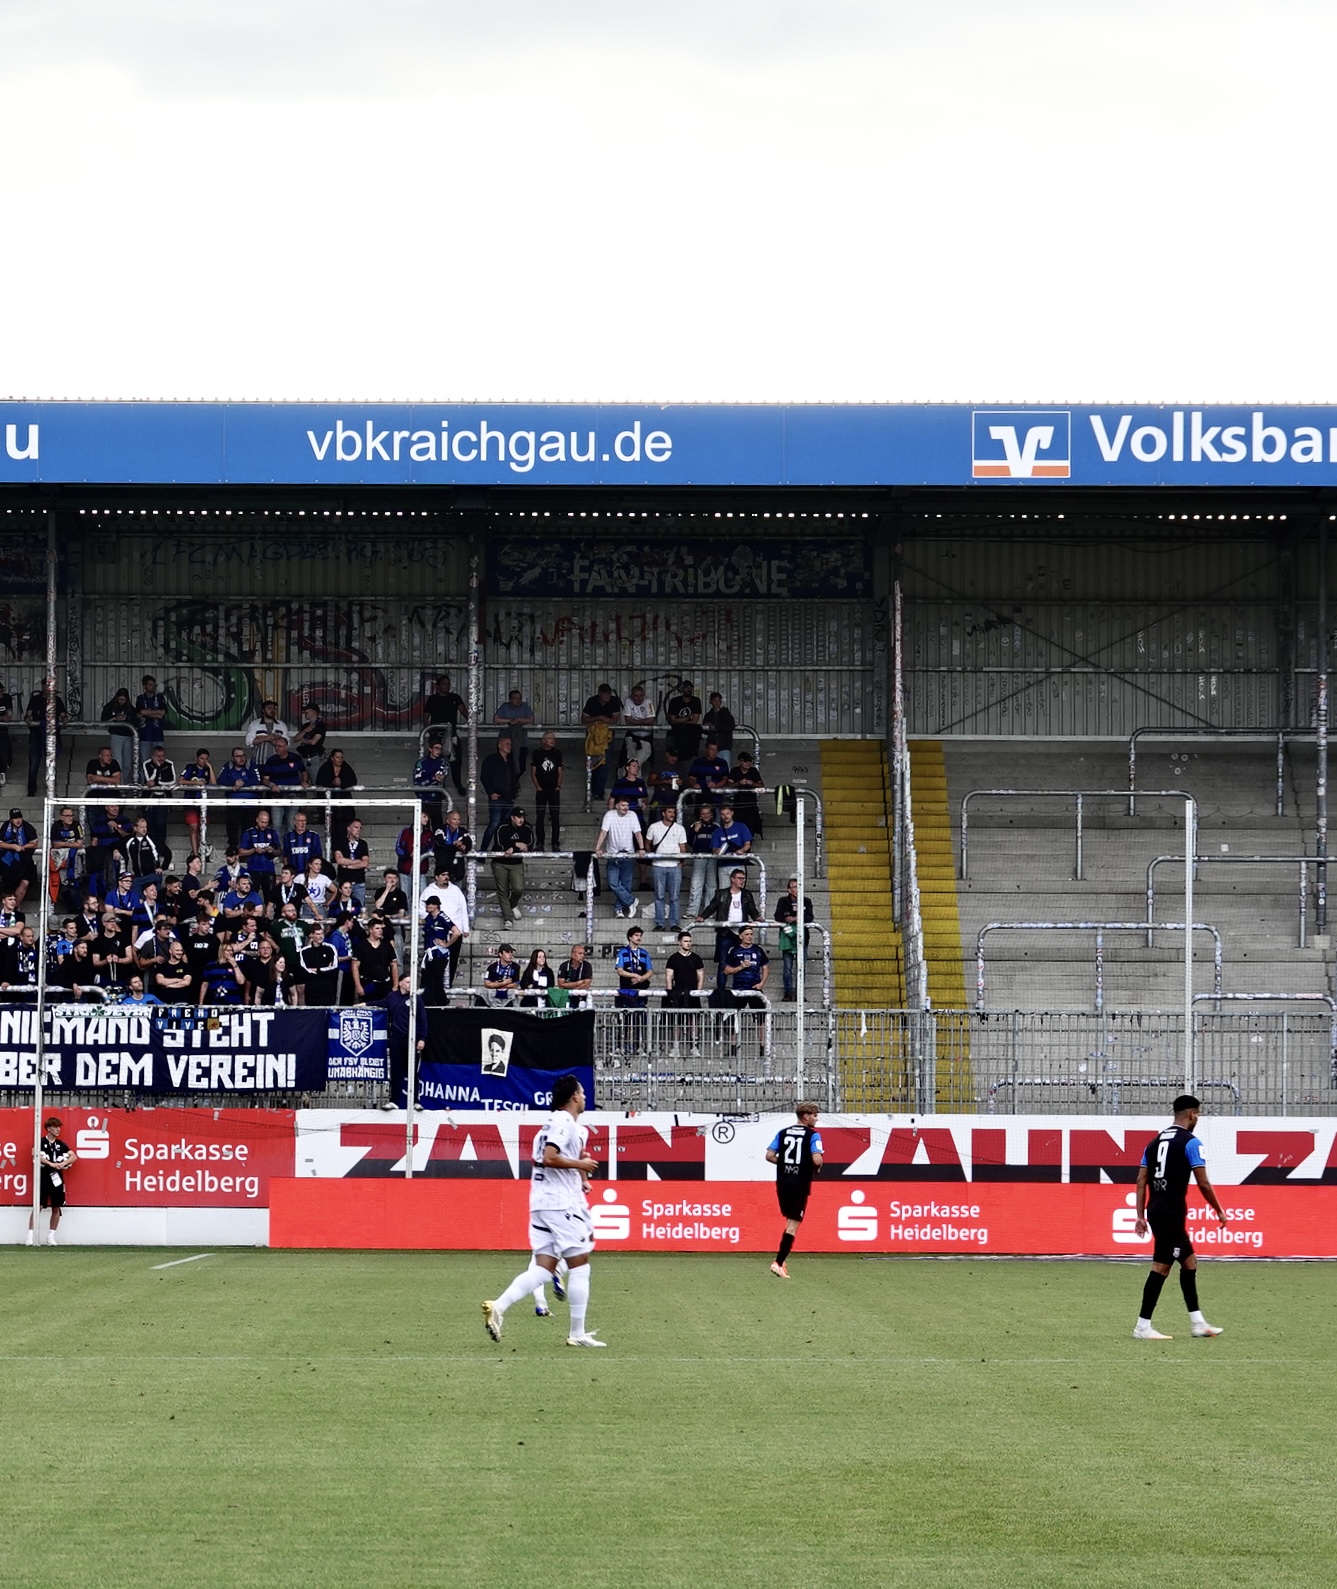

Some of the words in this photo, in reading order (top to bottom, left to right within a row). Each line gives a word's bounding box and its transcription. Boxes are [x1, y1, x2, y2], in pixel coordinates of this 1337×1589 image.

[306, 419, 673, 472] vbkraichgau.de
[75, 1053, 153, 1087] DEM
[166, 1054, 297, 1089] VEREIN!
[327, 1065, 385, 1079] UNABHÄNGIG
[328, 1057, 343, 1066] DER
[344, 1057, 358, 1066] FSV
[124, 1137, 249, 1165] Sparkasse
[783, 1136, 803, 1165] 21
[1153, 1140, 1170, 1179] 9
[1236, 1130, 1337, 1186] Z
[124, 1168, 260, 1199] Heidelberg
[642, 1199, 732, 1221] Sparkasse
[889, 1200, 981, 1222] Sparkasse
[1187, 1203, 1255, 1221] arksse
[642, 1221, 740, 1245] Heidelberg
[890, 1223, 989, 1246] Heidelberg
[1189, 1226, 1264, 1248] idelberg
